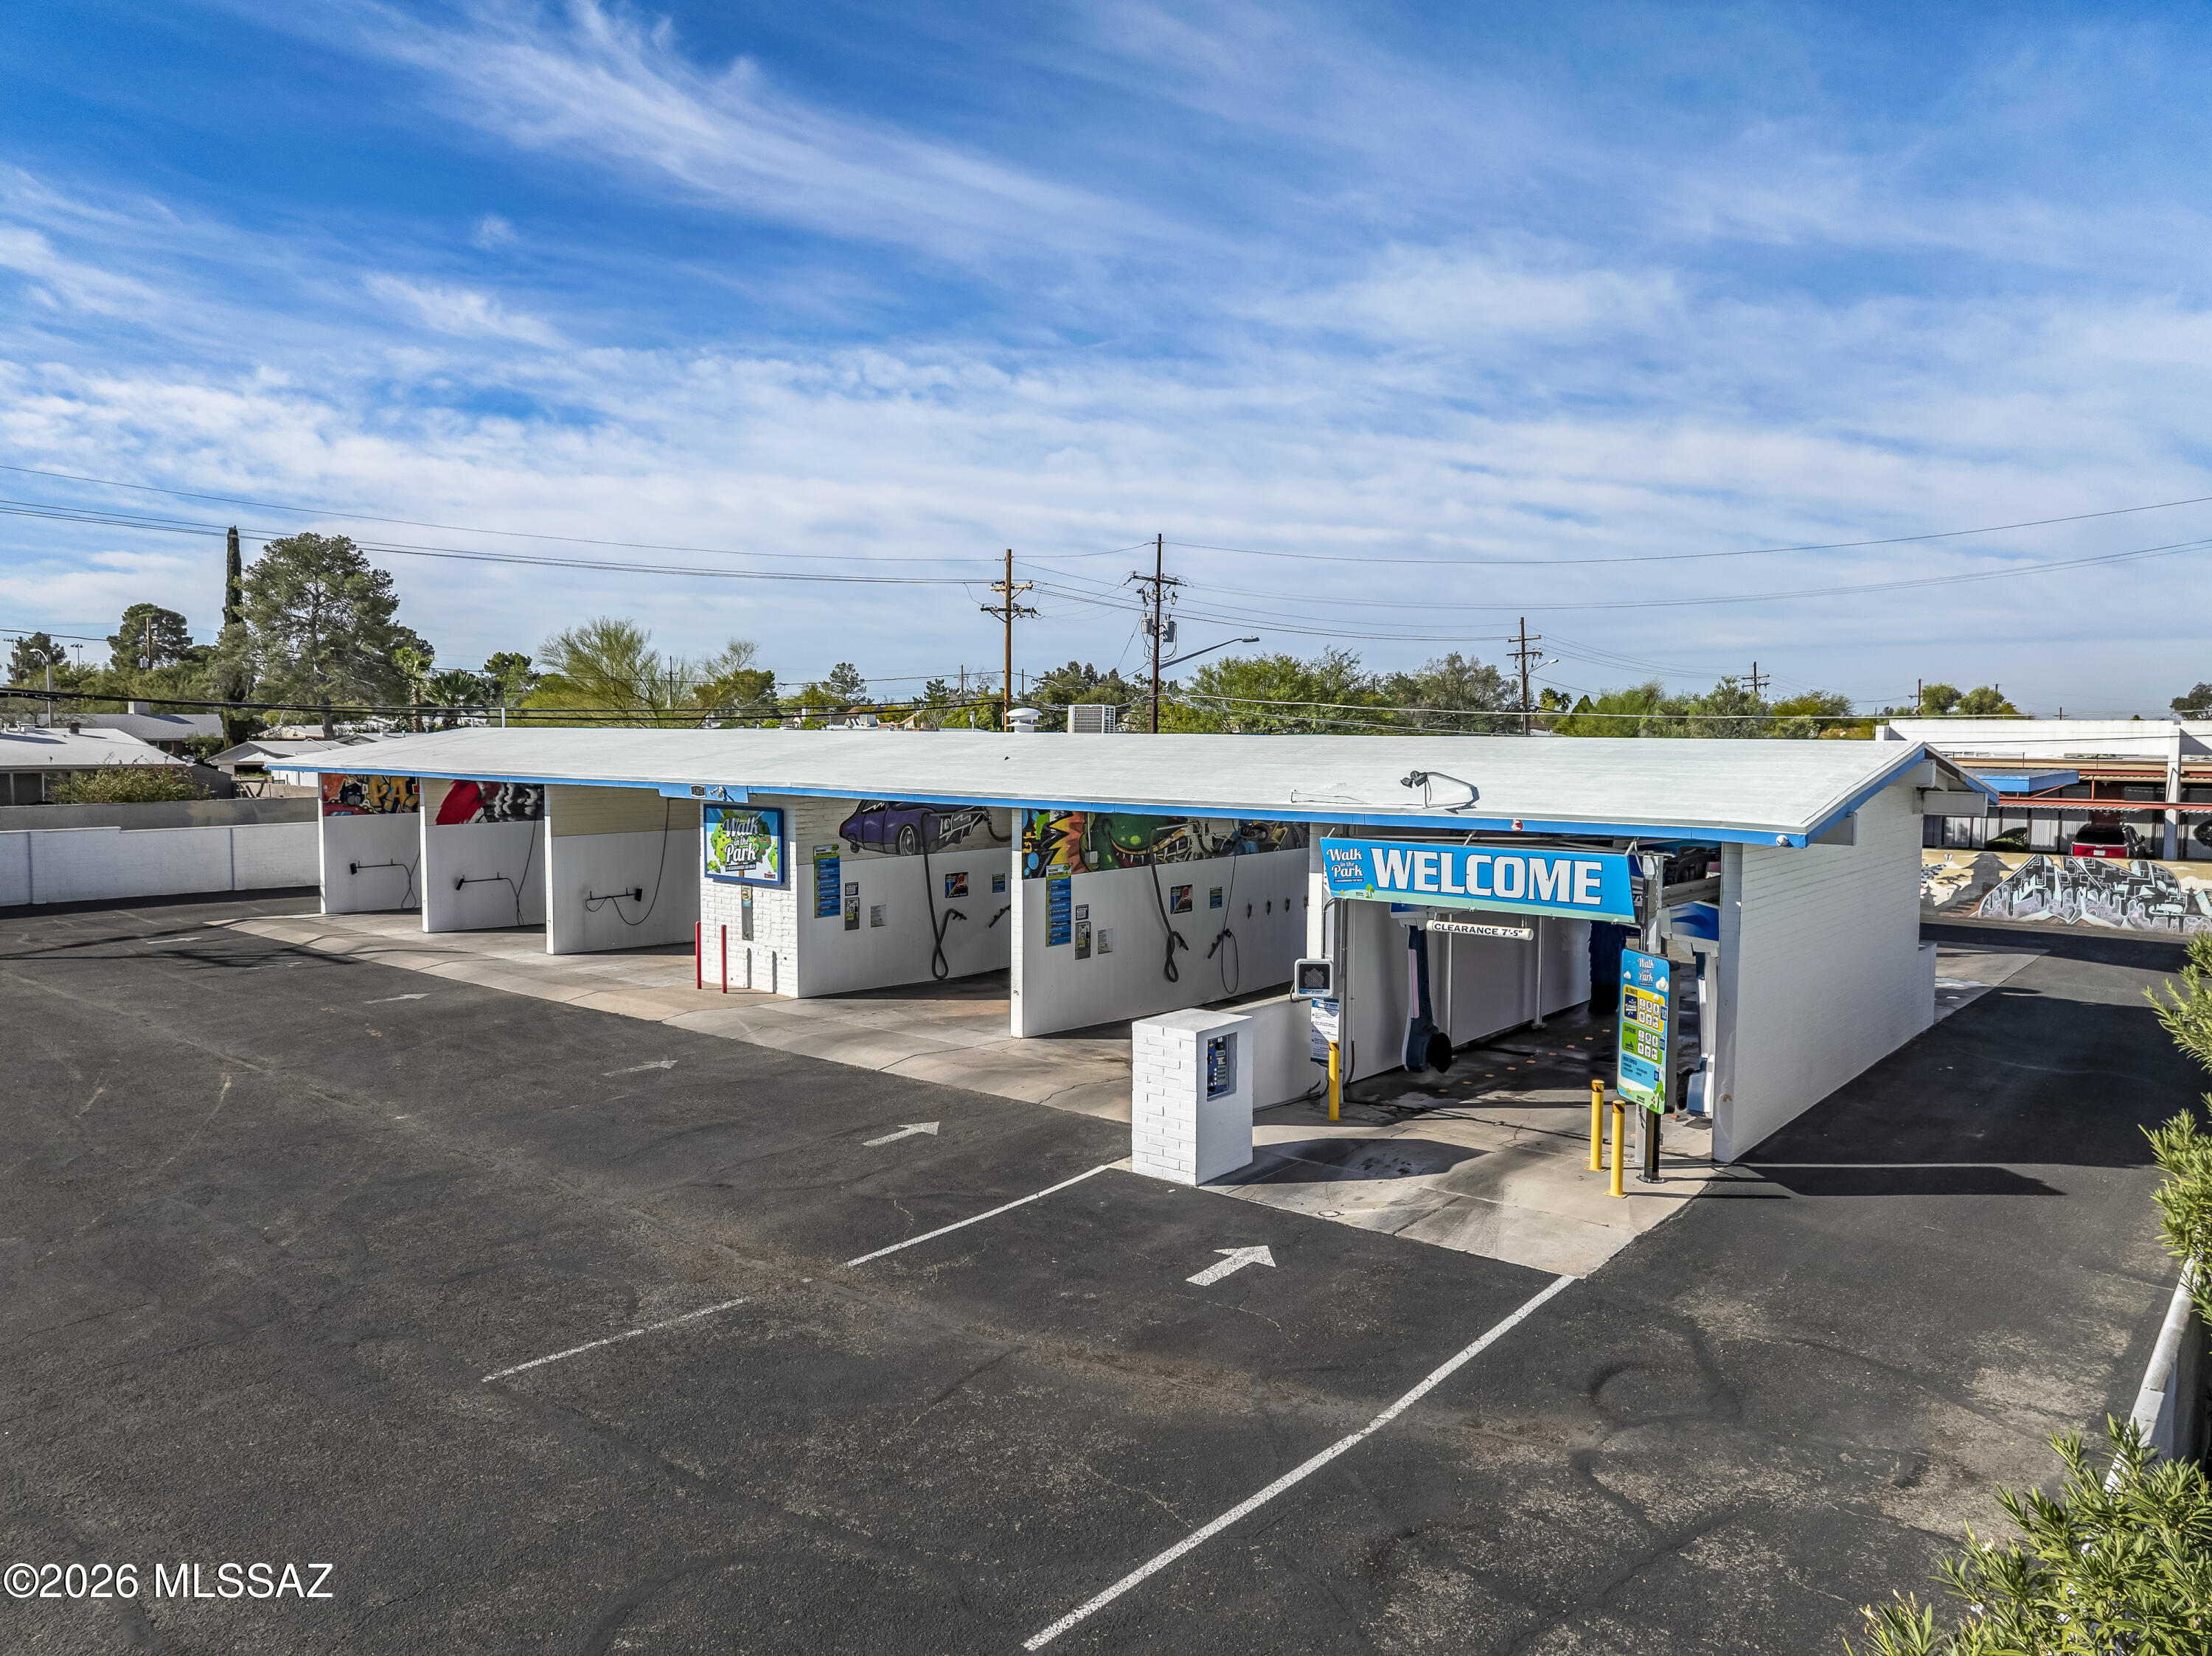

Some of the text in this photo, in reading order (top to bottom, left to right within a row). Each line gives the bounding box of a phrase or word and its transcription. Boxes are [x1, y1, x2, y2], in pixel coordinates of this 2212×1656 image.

[722, 816, 759, 838] Walk
[734, 837, 749, 846] in the
[724, 843, 757, 863] Park
[1326, 848, 1363, 861] Walk
[1332, 864, 1363, 877] Park
[1370, 847, 1603, 905] WELCOME
[1434, 923, 1523, 936] CLEARANCE 7'-5"
[1638, 958, 1654, 969] Walk
[1639, 971, 1653, 982] Park
